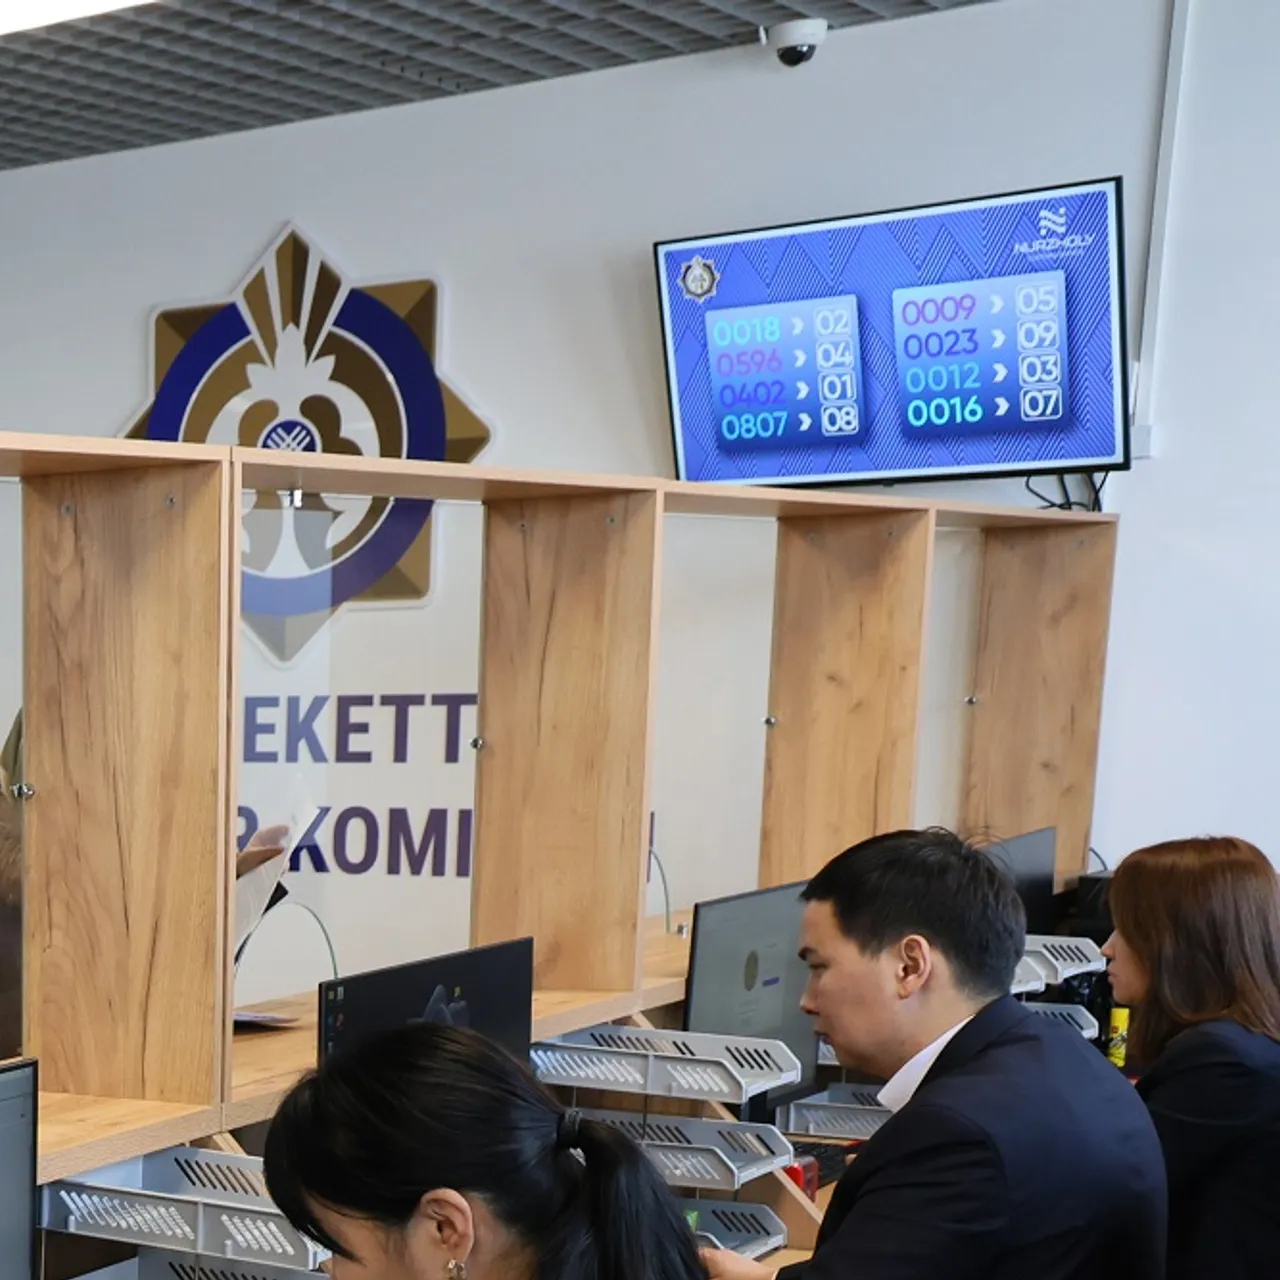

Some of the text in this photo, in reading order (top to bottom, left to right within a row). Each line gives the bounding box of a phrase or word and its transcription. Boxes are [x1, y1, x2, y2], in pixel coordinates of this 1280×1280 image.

[902, 285, 1057, 326] 0009 05
[713, 309, 849, 347] 0018 02
[904, 320, 1057, 360] 0023 09
[716, 342, 853, 378] 0596 04
[906, 356, 1057, 394] 0012 03
[720, 374, 853, 408] 0402 01
[907, 390, 1057, 427] 0016 07
[721, 407, 855, 440] 0807 08
